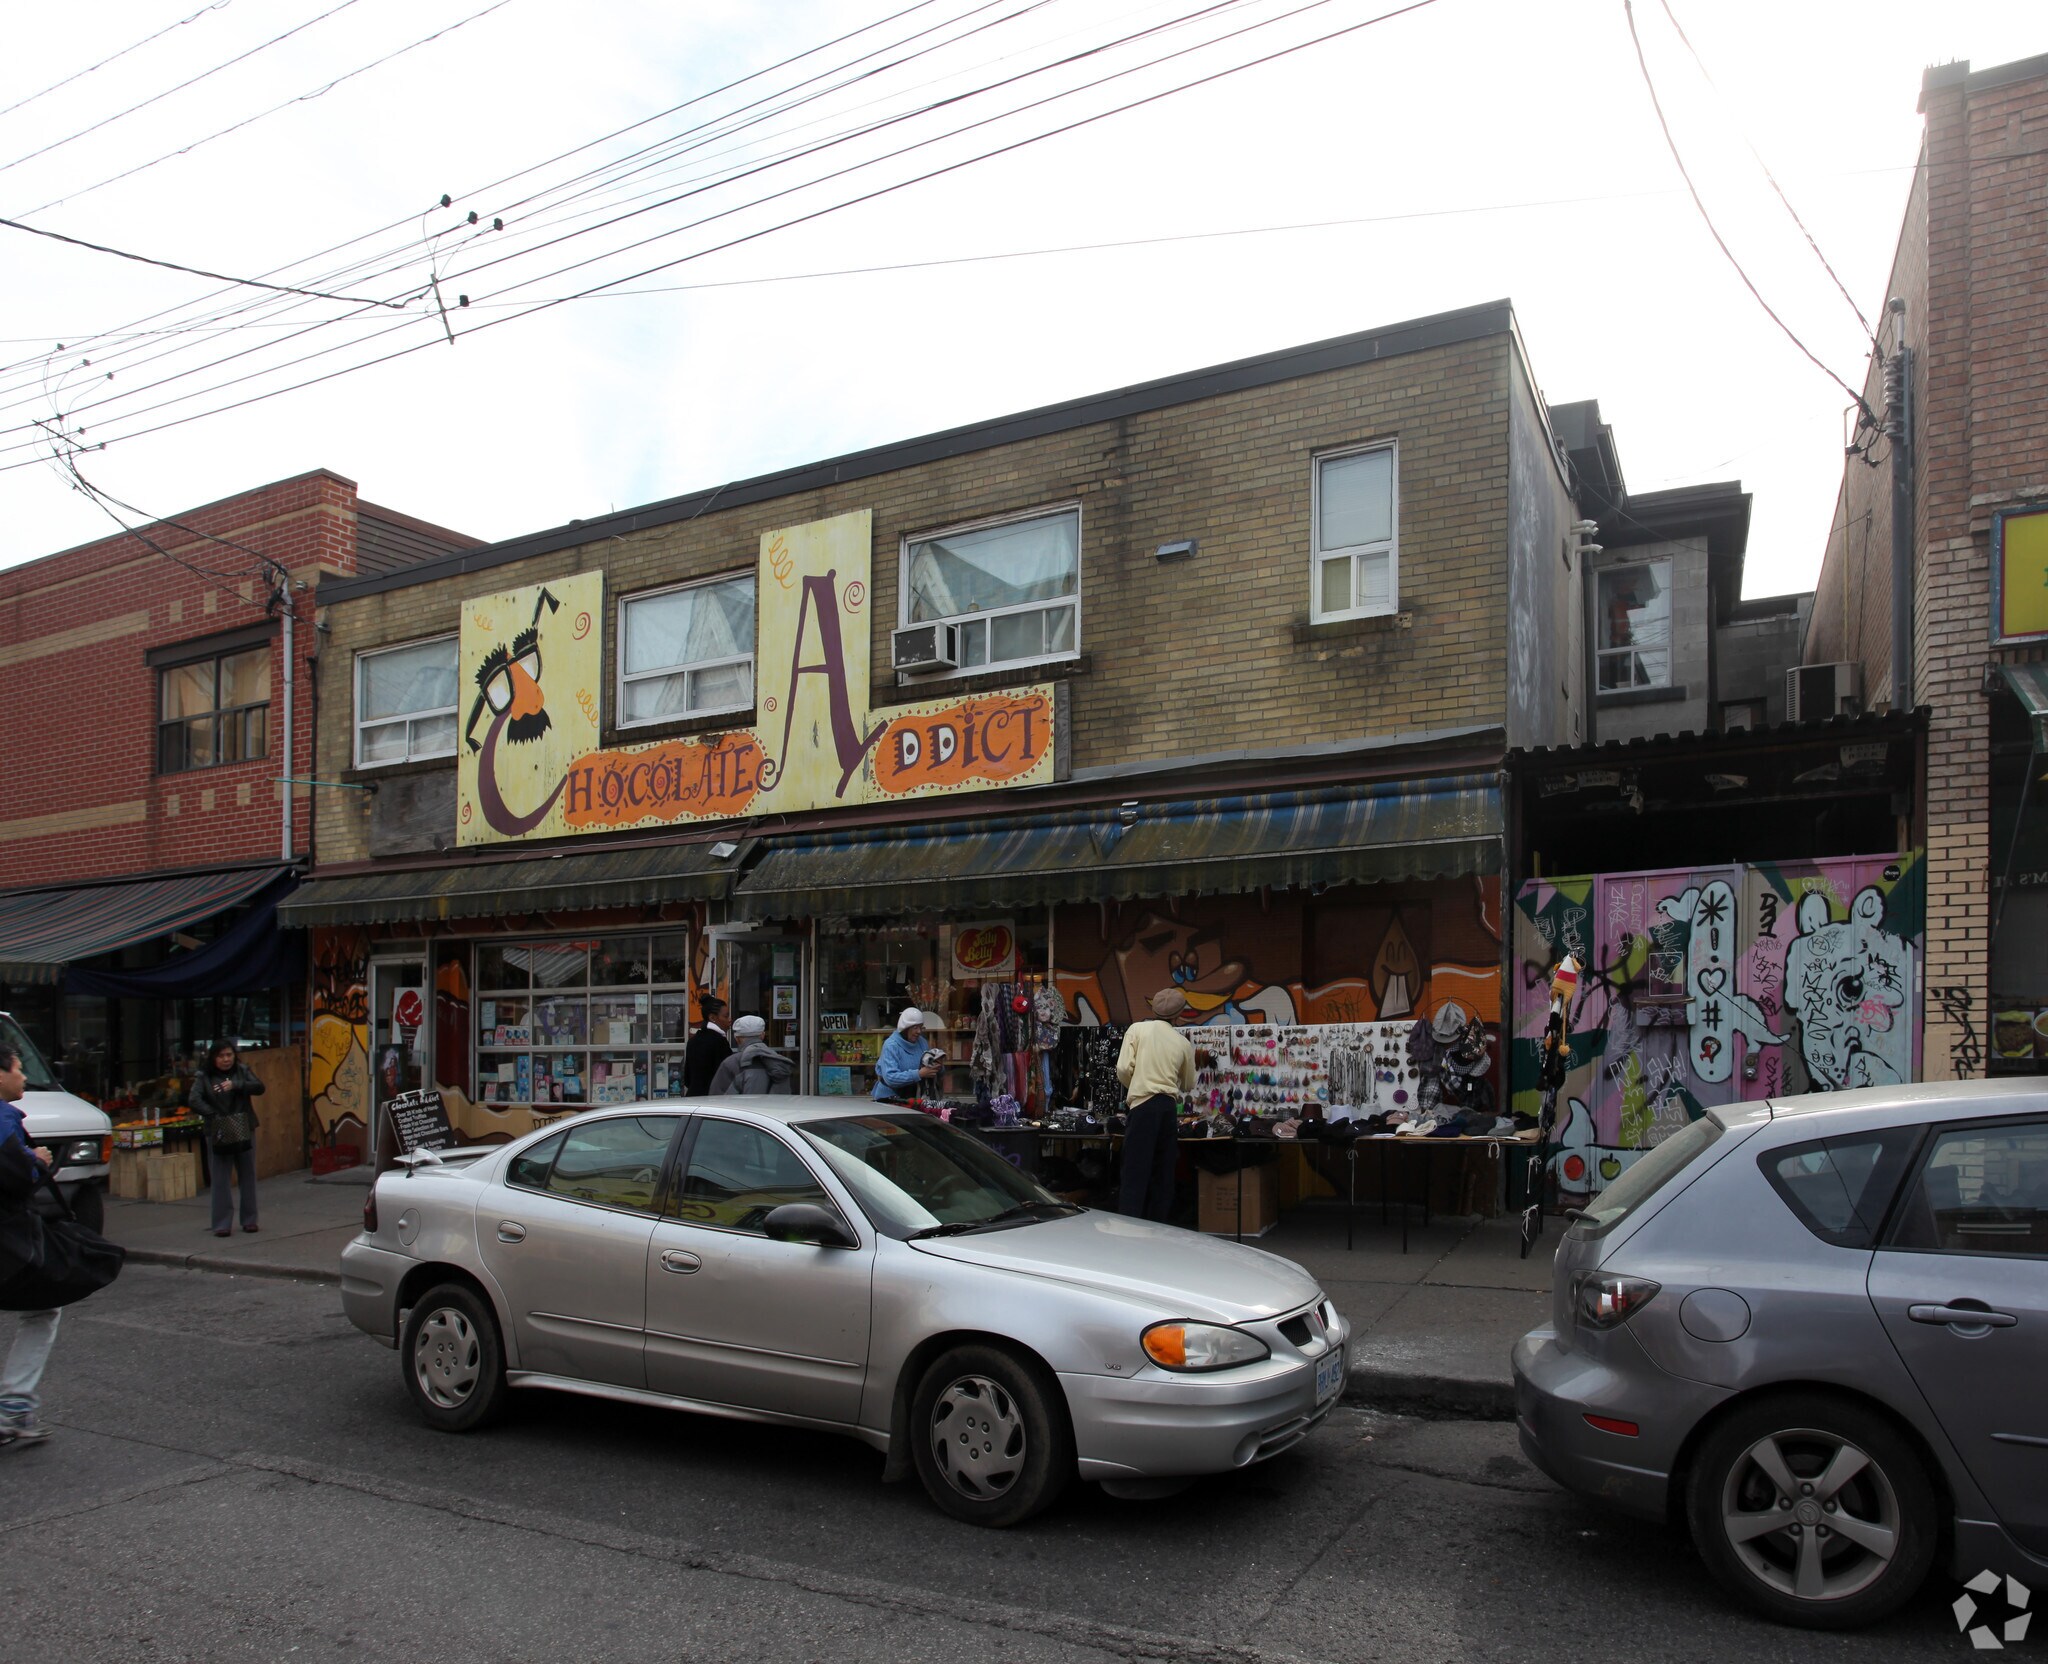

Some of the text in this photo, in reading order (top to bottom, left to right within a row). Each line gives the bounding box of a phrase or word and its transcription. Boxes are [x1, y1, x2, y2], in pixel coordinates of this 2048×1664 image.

[973, 925, 997, 947] Jelly
[964, 946, 993, 968] Belly
[823, 1015, 848, 1030] OPEN
[391, 1099, 418, 1110] Chocolate
[1104, 1362, 1121, 1370] V6
